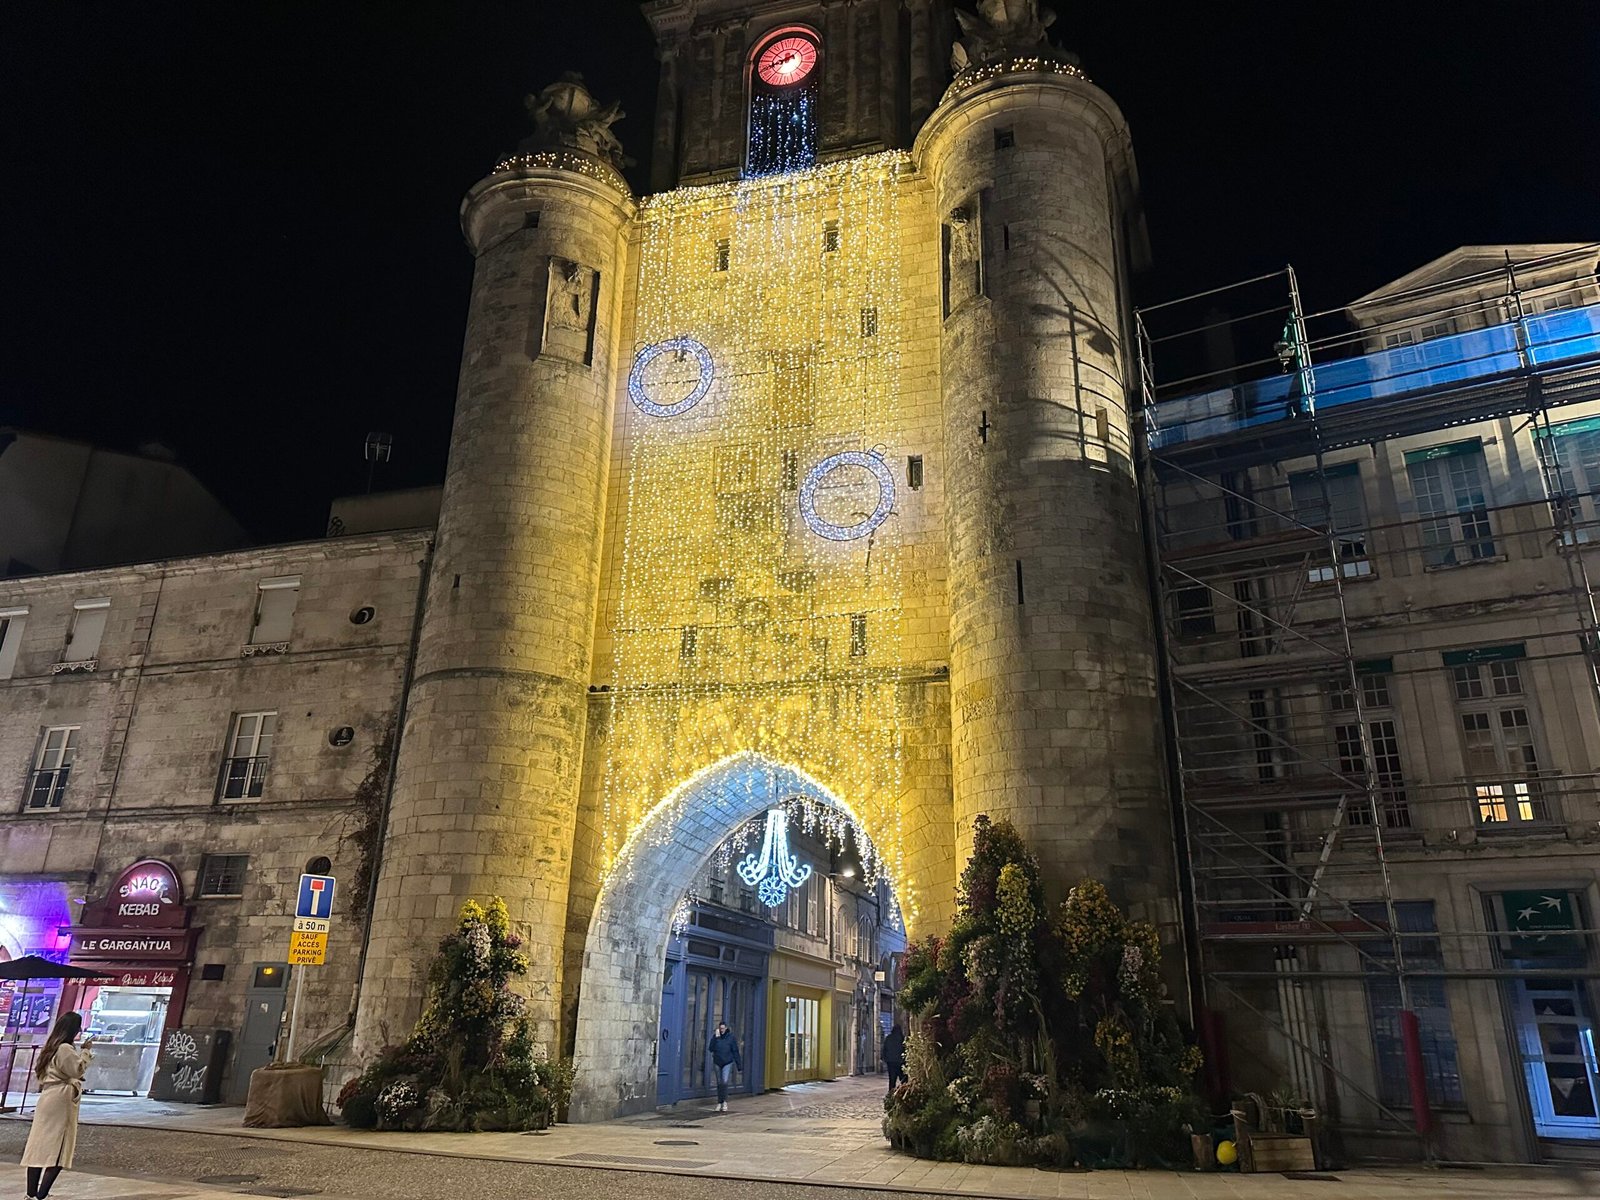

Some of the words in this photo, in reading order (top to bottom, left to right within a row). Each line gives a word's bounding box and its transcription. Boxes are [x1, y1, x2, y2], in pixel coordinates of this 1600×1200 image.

[118, 903, 160, 916] KEBAB
[298, 920, 304, 930] à
[306, 922, 316, 930] 50
[81, 940, 97, 950] LE
[99, 939, 172, 951] GARGANTUA
[121, 973, 148, 986] Panini
[150, 971, 175, 985] Kebab
